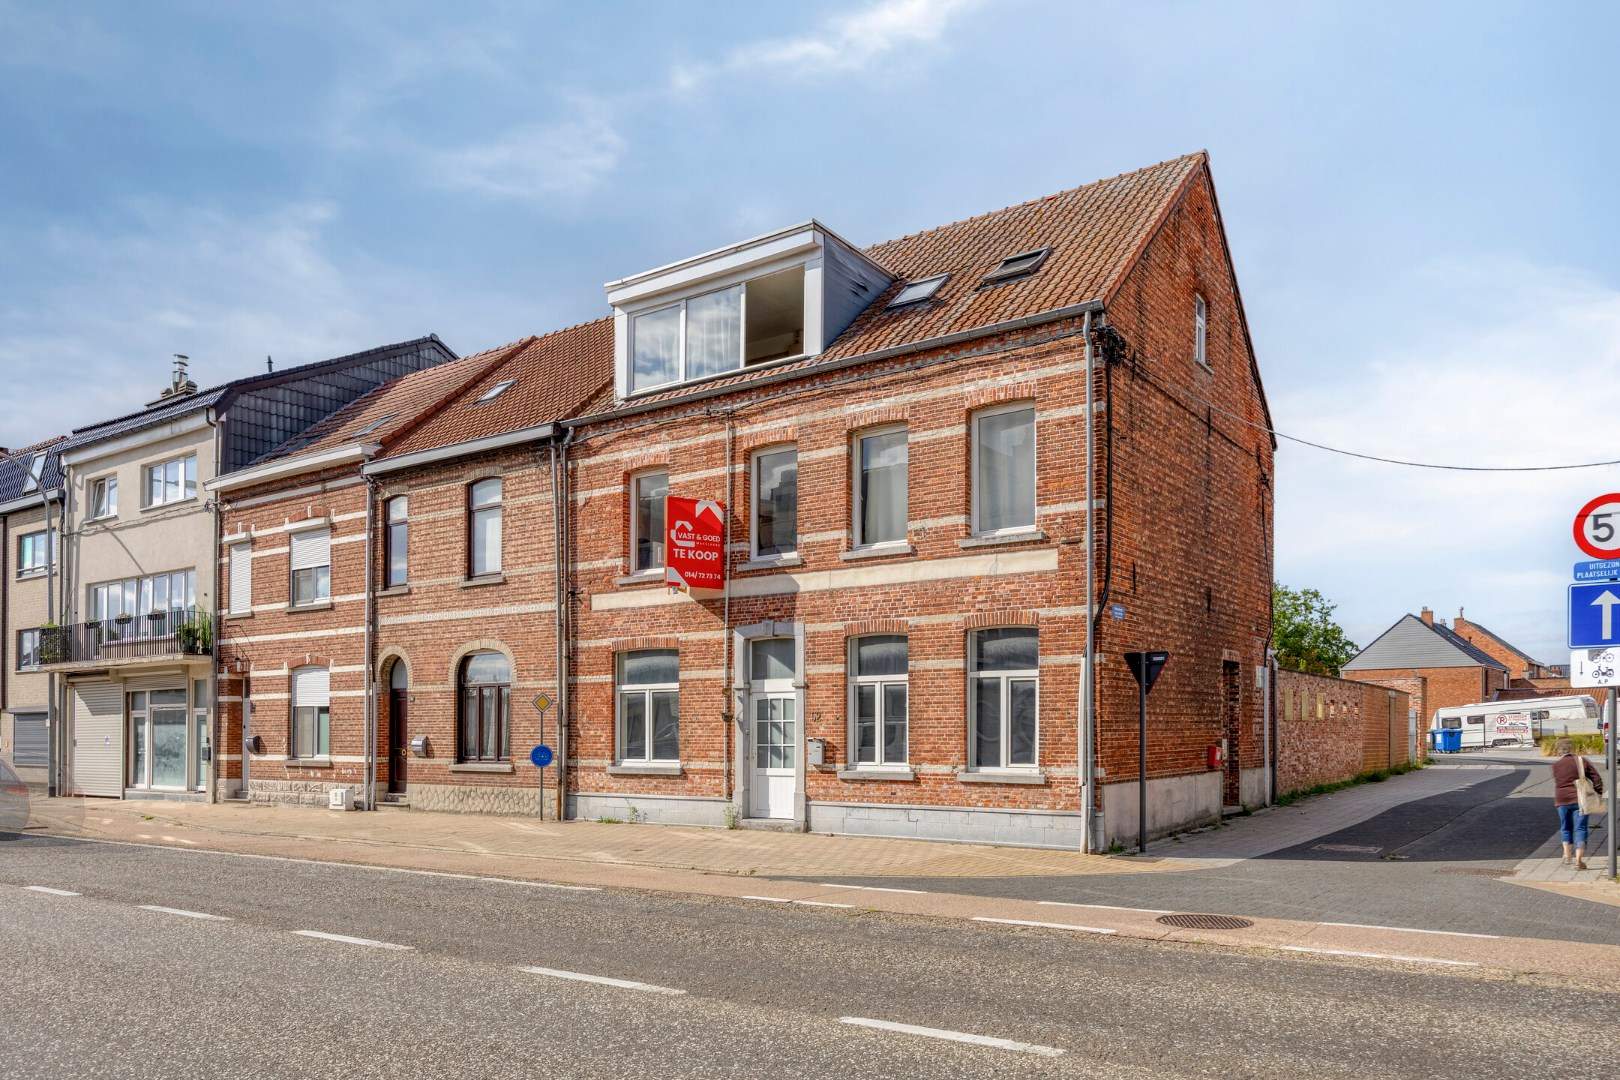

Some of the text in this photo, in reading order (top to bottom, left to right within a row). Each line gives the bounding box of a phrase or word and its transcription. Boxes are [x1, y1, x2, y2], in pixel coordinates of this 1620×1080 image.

[1592, 513, 1614, 542] 5
[678, 532, 695, 540] VAST
[702, 534, 720, 542] GOED
[673, 548, 719, 561] TE KOOP
[1576, 569, 1618, 579] PLAATSELIJK
